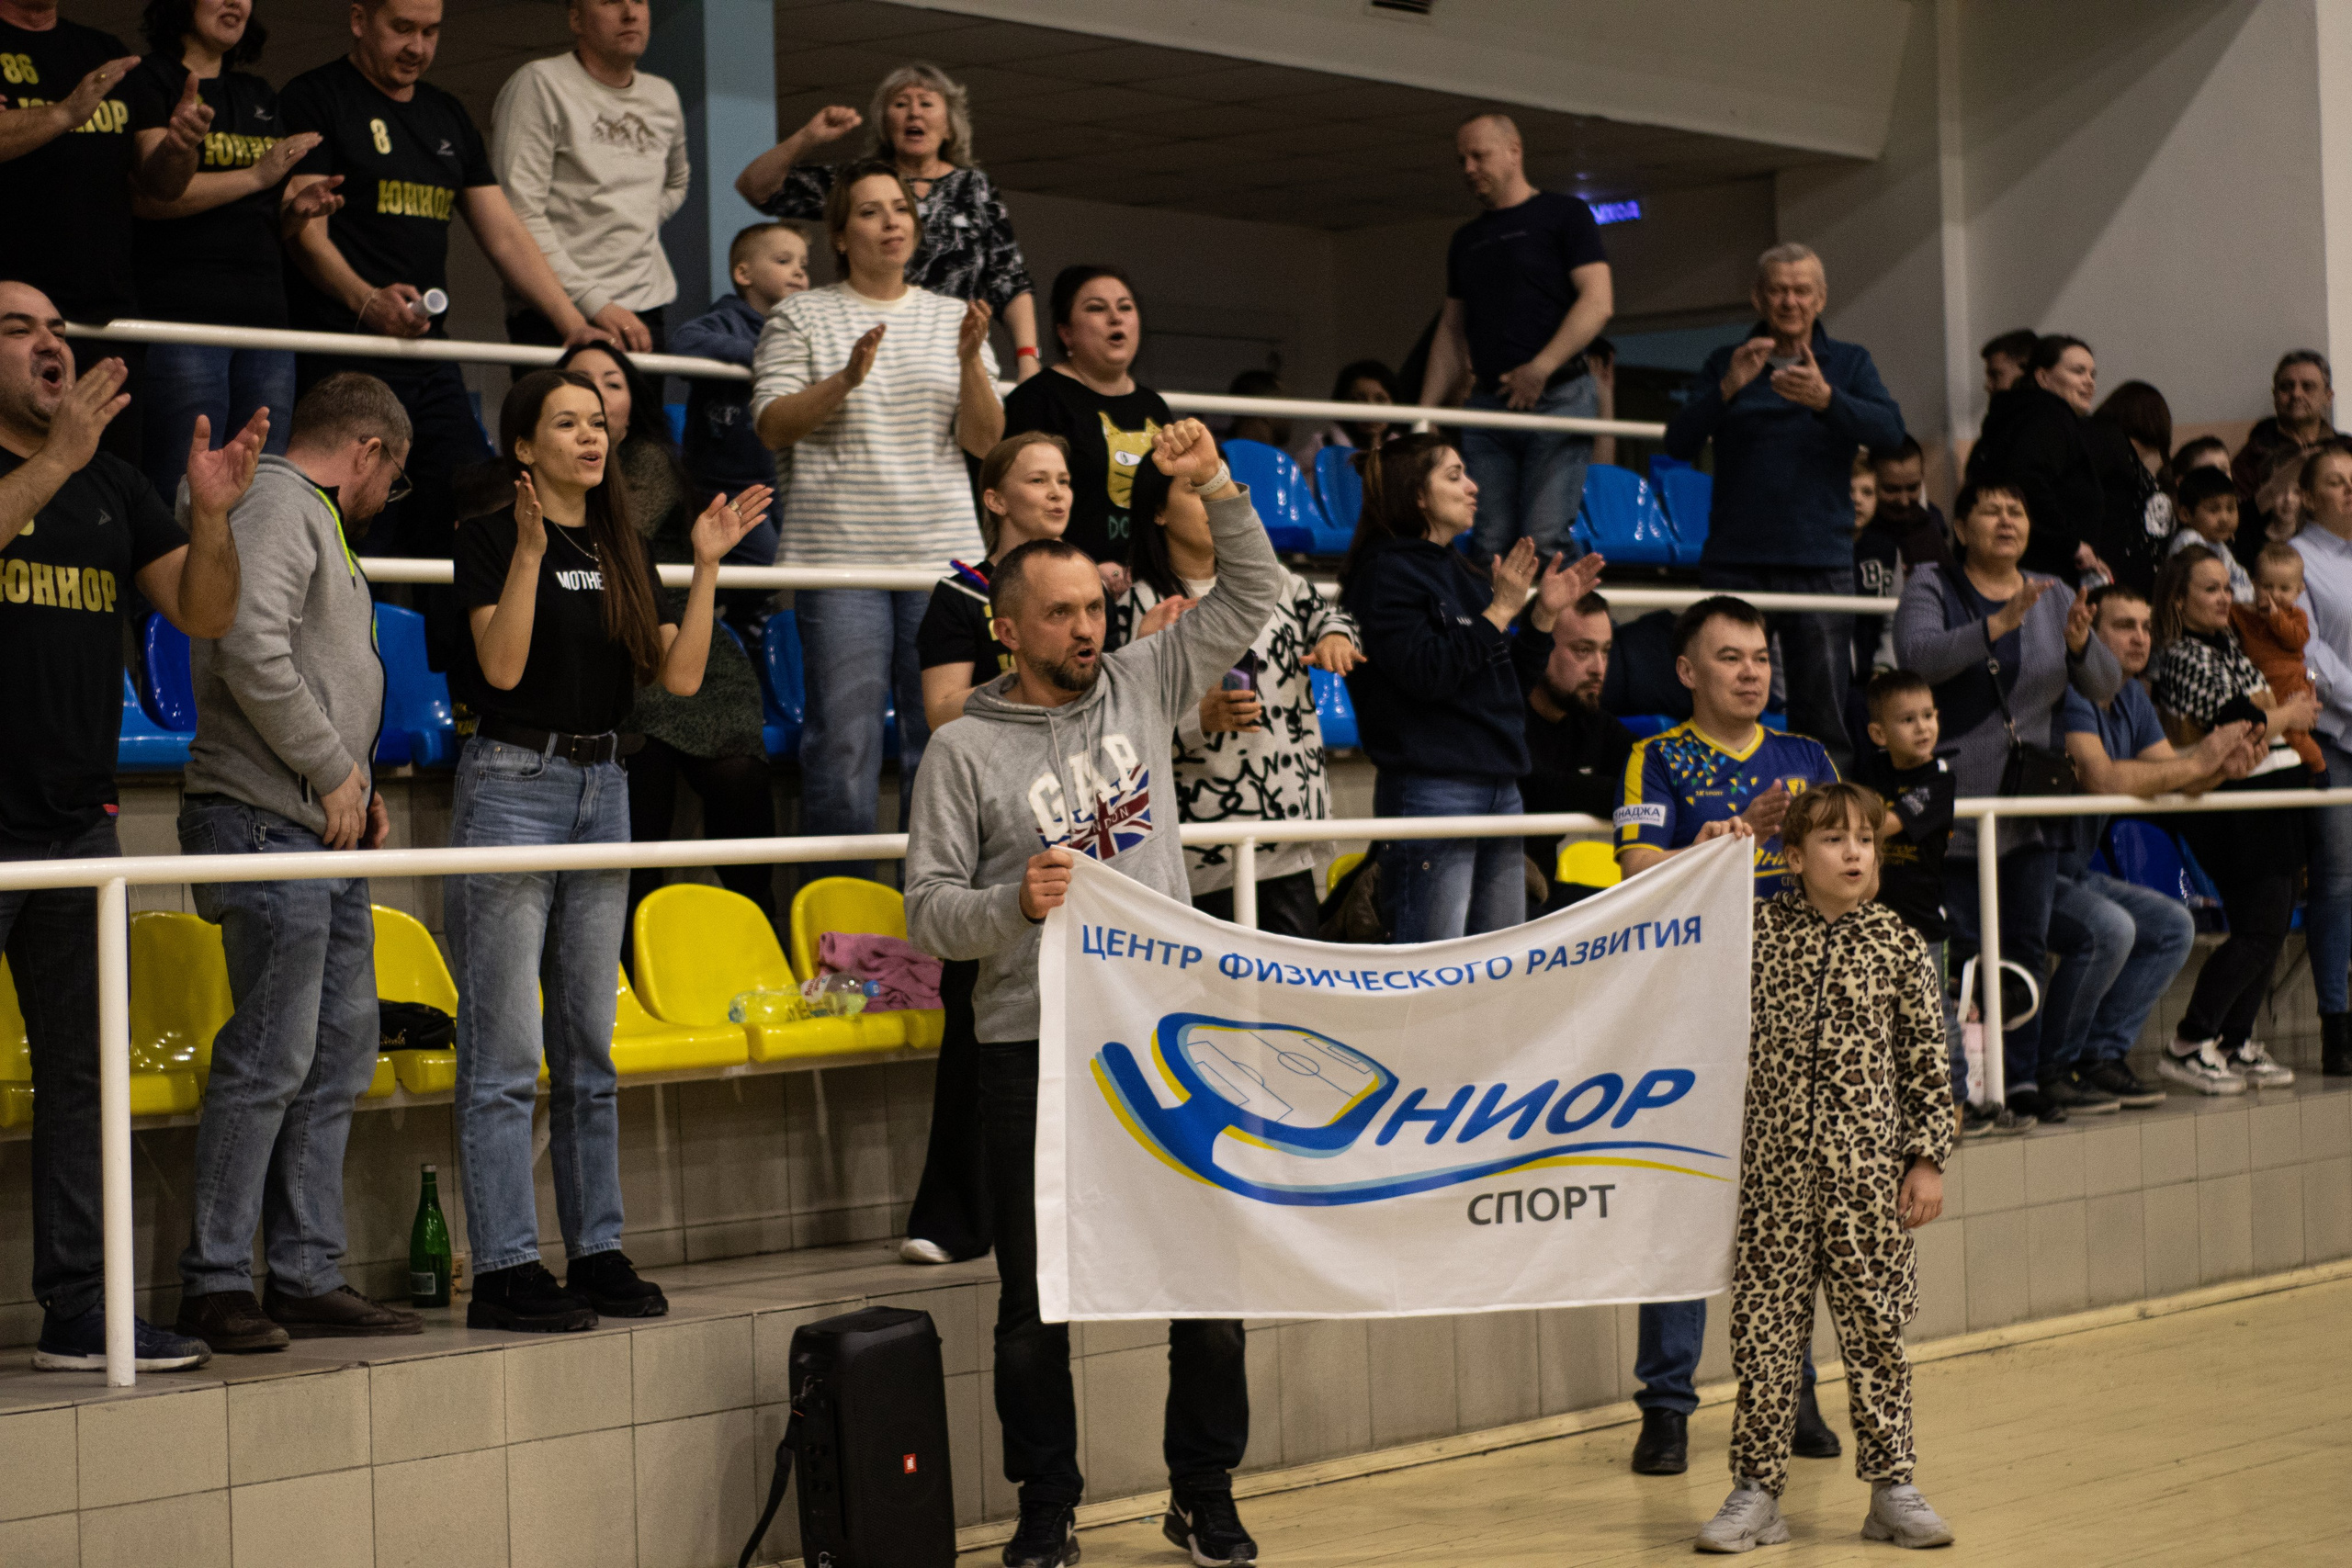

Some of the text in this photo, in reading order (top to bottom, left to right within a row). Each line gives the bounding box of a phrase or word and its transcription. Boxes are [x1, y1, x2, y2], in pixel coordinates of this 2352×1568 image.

[0, 51, 40, 85] 86
[203, 131, 285, 166] ЮНИ
[369, 118, 392, 155] 8
[0, 557, 117, 614] ЮНИОР
[1028, 734, 1138, 842] GAP
[1082, 915, 1702, 991] ЦЕНТР ФИЗИЧЕСКОГО РАЗВИТИЯ
[1090, 1011, 1696, 1206] ЮНИОР
[1467, 1184, 1615, 1224] СПОРТ
